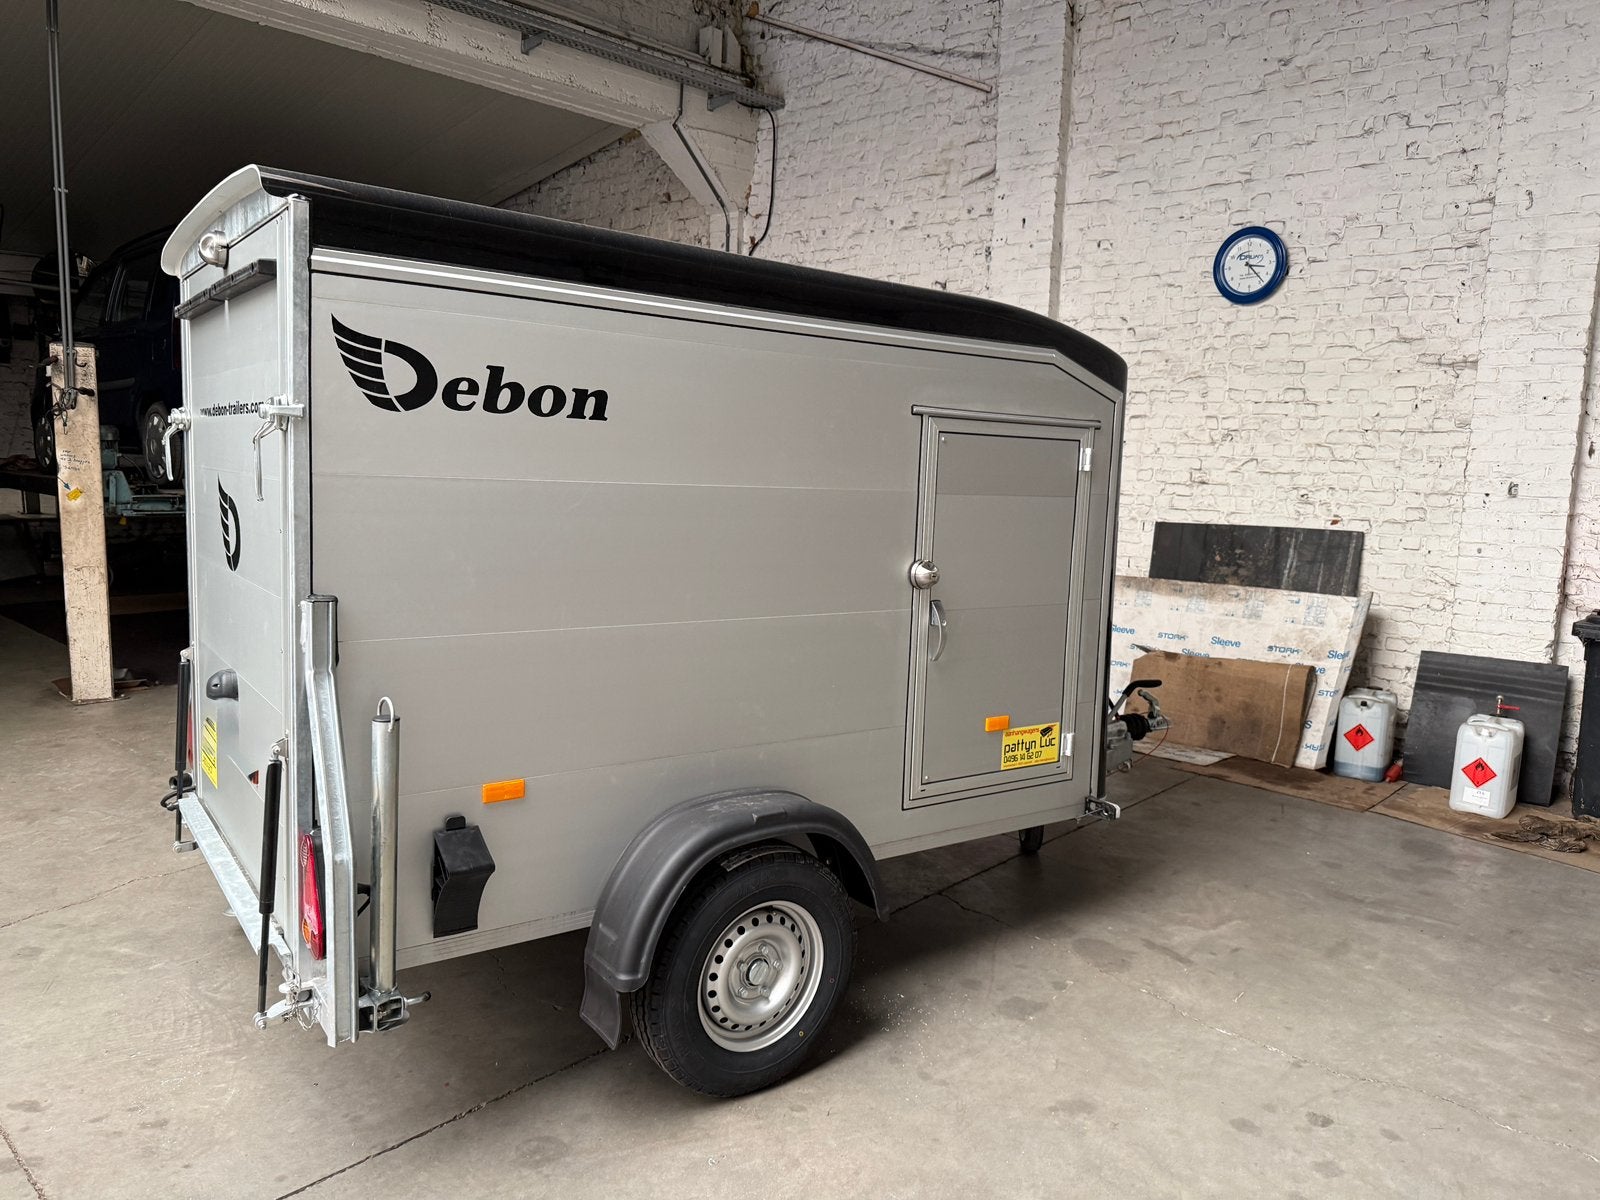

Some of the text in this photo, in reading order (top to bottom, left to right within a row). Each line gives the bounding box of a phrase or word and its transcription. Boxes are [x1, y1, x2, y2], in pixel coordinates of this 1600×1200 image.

[331, 314, 609, 421] Debon
[1210, 636, 1242, 648] Sleeve
[1004, 736, 1056, 755] pattyn Luc
[1004, 754, 1018, 763] 0496
[1027, 752, 1034, 760] 62
